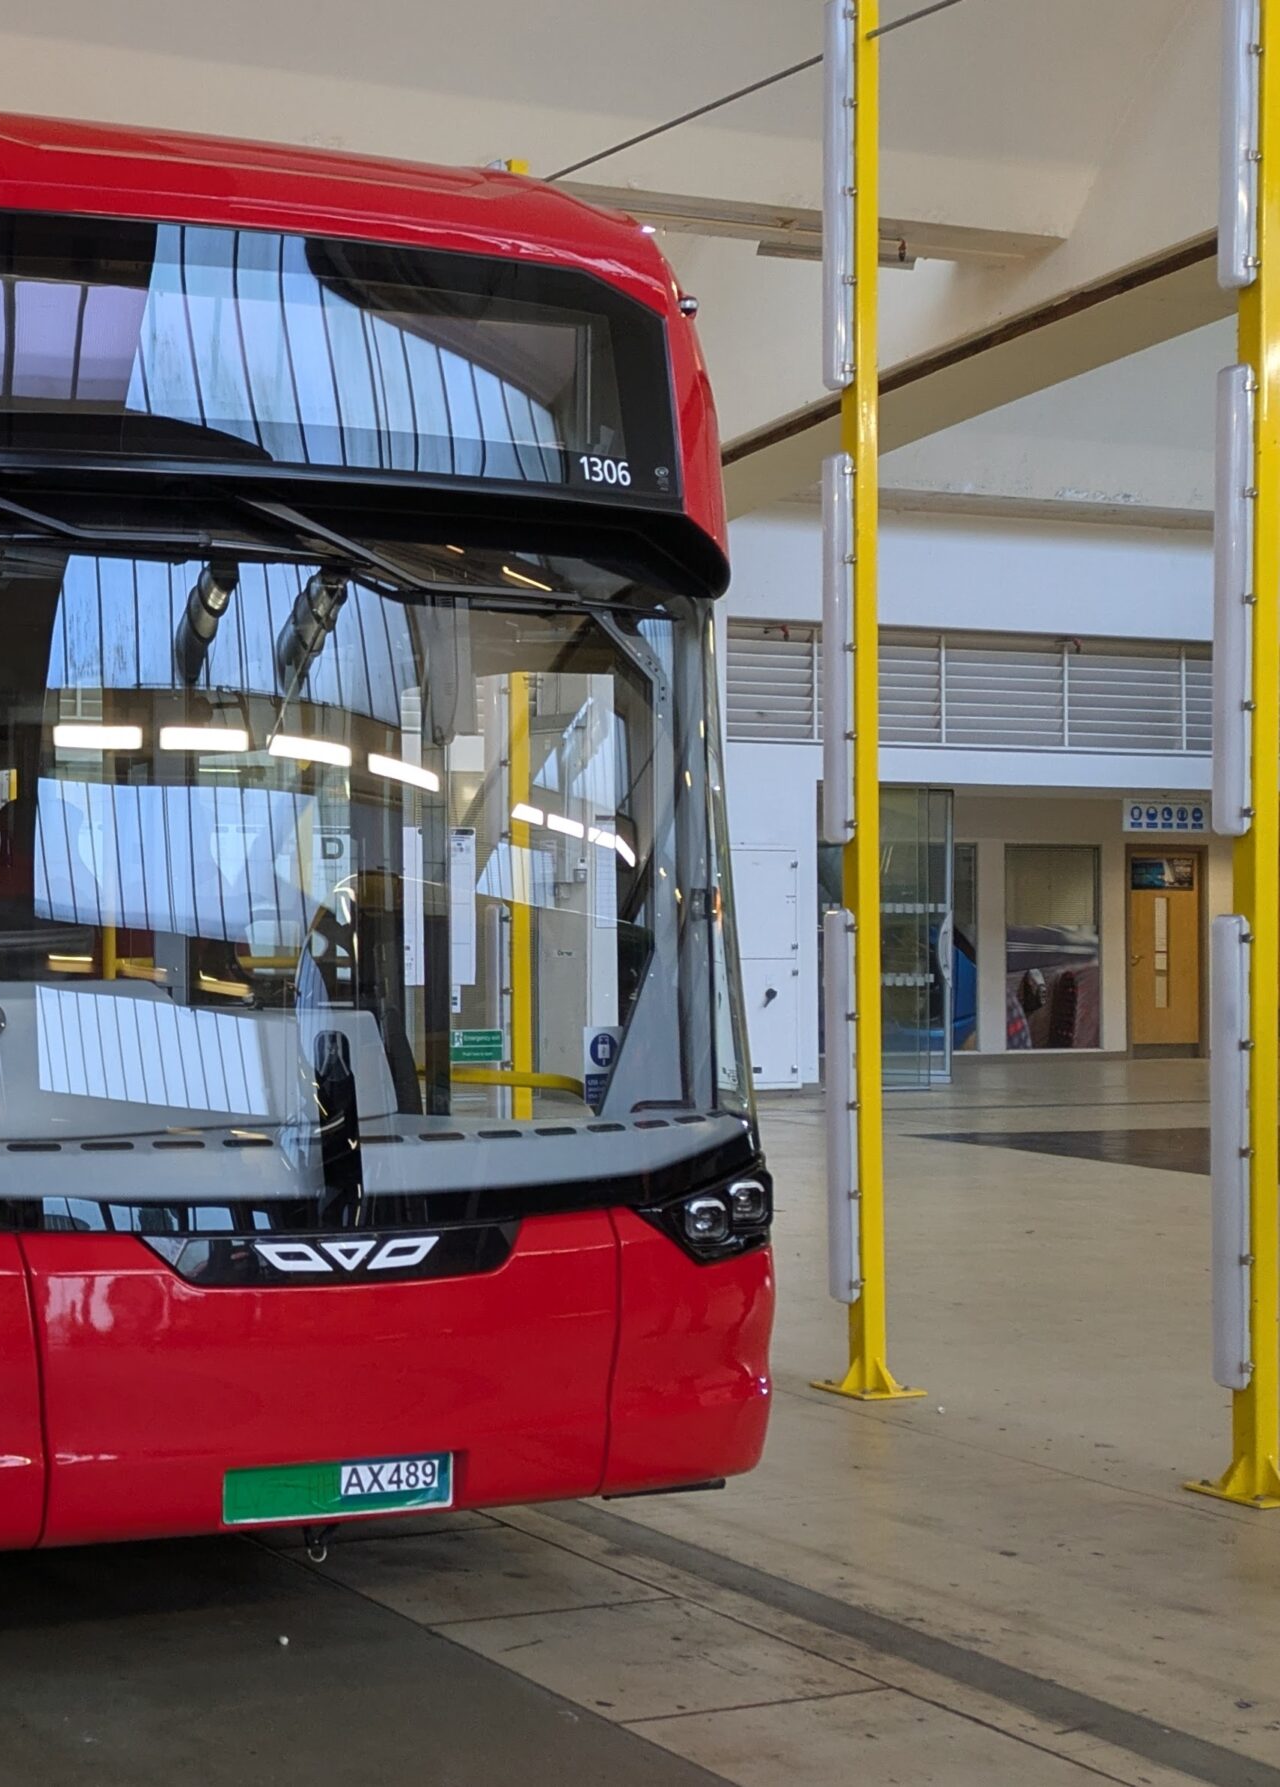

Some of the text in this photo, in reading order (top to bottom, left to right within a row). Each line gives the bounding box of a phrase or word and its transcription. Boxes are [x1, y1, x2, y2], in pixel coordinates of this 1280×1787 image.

[579, 456, 631, 487] 1306
[321, 837, 344, 860] D
[344, 1461, 436, 1495] AX489
